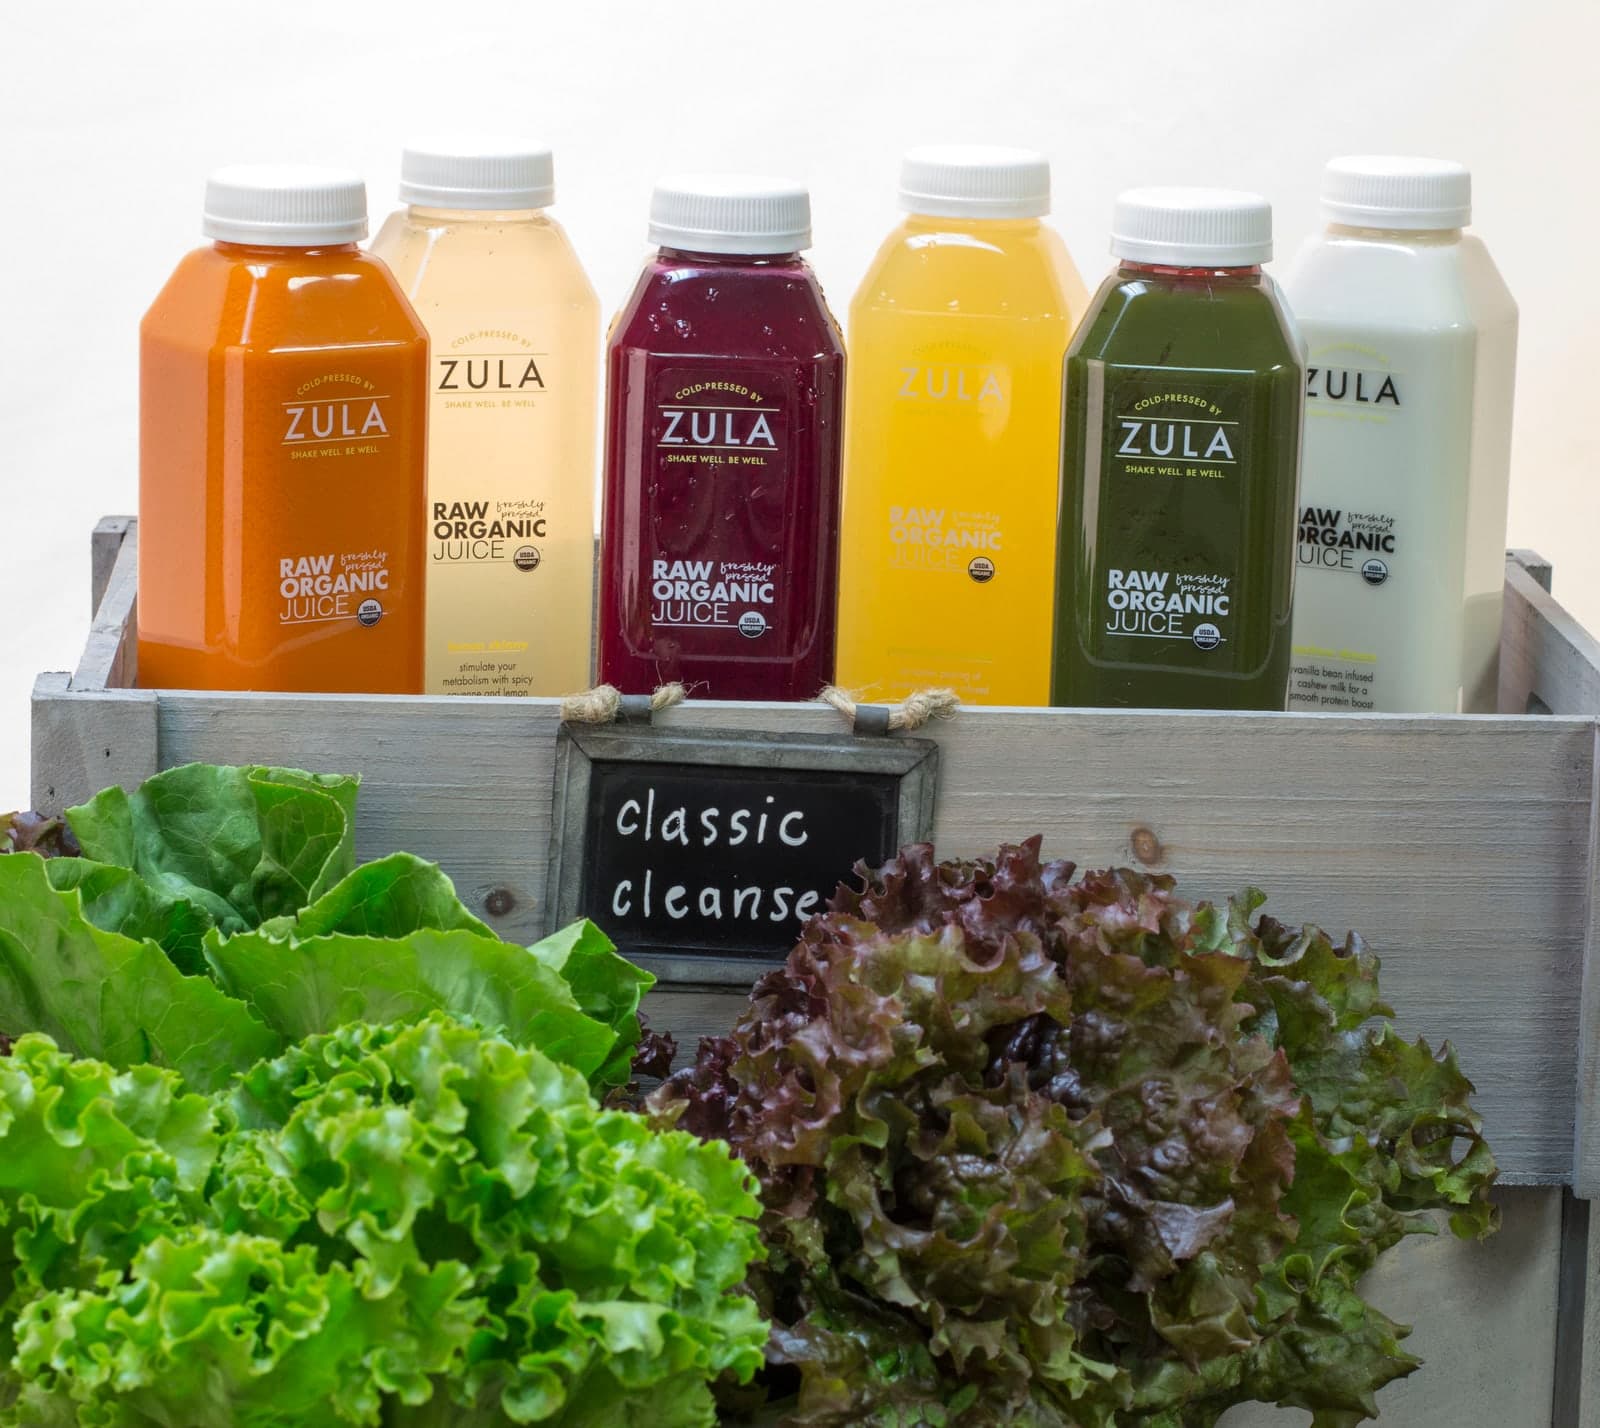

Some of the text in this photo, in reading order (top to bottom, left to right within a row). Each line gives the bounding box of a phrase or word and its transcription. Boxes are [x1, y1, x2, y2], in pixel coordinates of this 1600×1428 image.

[438, 357, 545, 390] ZULA
[898, 367, 1004, 401] ZULA
[675, 382, 763, 403] COLD-PRESSED BY
[1307, 368, 1400, 406] ZULA
[1134, 393, 1222, 416] COLD-PRESSED BY
[284, 400, 388, 440] ZULA
[660, 411, 776, 446] ZULA
[1118, 421, 1234, 459] ZULA
[291, 449, 318, 460] SHAKE
[667, 454, 697, 463] SHAKE
[728, 456, 740, 464] BE
[1125, 465, 1155, 475] SHAKE
[1186, 468, 1197, 477] BE
[433, 501, 489, 520] RAW
[889, 505, 945, 526] RAW
[1299, 507, 1342, 528] AW
[433, 519, 547, 540] ORGANIC
[890, 526, 1003, 551] ORGANIC
[433, 540, 505, 560] JUICE
[1296, 545, 1355, 569] UICE
[280, 554, 336, 579] RAW
[652, 559, 714, 581] RAW
[280, 569, 389, 599] ORGANIC
[652, 580, 775, 604] ORGANIC
[1108, 569, 1170, 592] RAW
[1175, 573, 1231, 588] freshly
[279, 594, 351, 621] JUICE
[651, 600, 730, 623] JUICE
[1107, 589, 1230, 616] ORGANIC
[1106, 610, 1184, 634] JUICE
[459, 661, 516, 673] stimulate your
[1292, 665, 1374, 683] vanilla bean infused
[442, 674, 533, 686] metabolism with spicy
[1297, 679, 1368, 695] cashew milk for a
[1321, 694, 1349, 706] protein
[1351, 697, 1374, 709] boost
[616, 788, 808, 847] classic
[612, 869, 823, 922] cleanse
